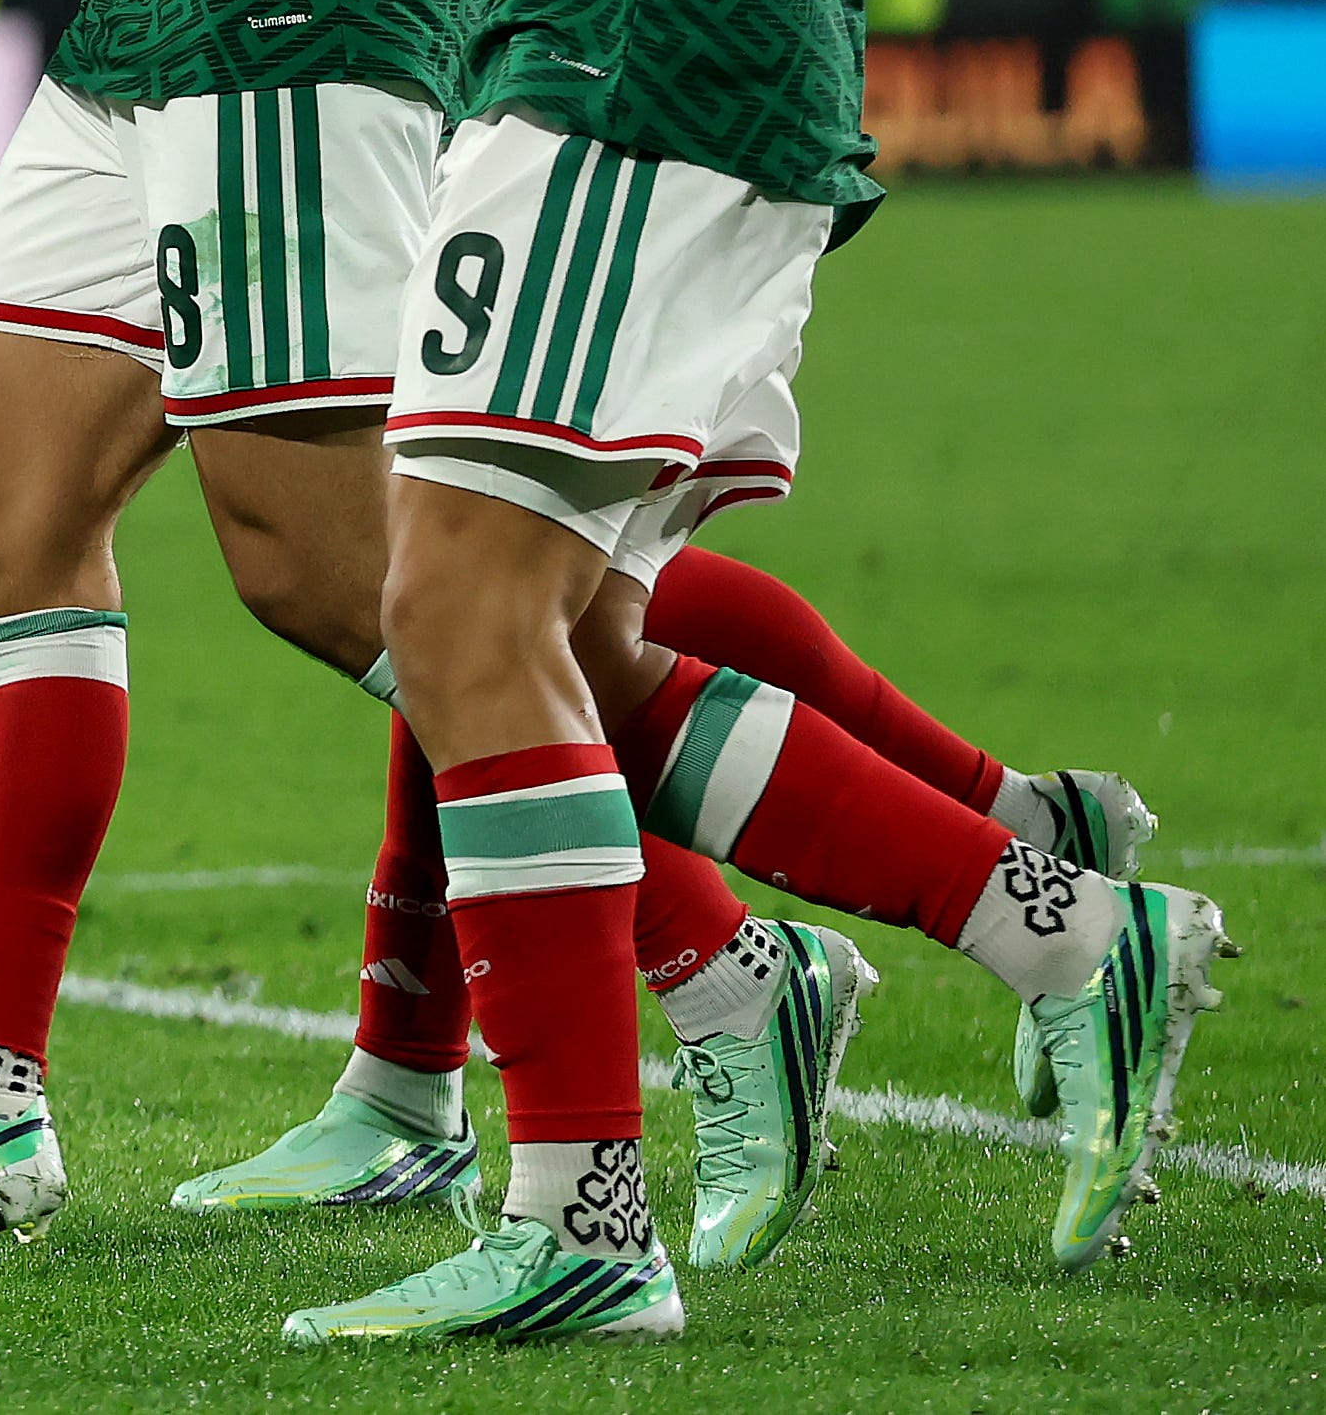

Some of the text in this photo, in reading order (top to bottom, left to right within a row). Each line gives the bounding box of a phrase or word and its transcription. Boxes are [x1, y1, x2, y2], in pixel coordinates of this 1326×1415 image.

[248, 14, 312, 28] CLIMACOOL
[156, 223, 203, 370] 8
[421, 231, 505, 375] 9
